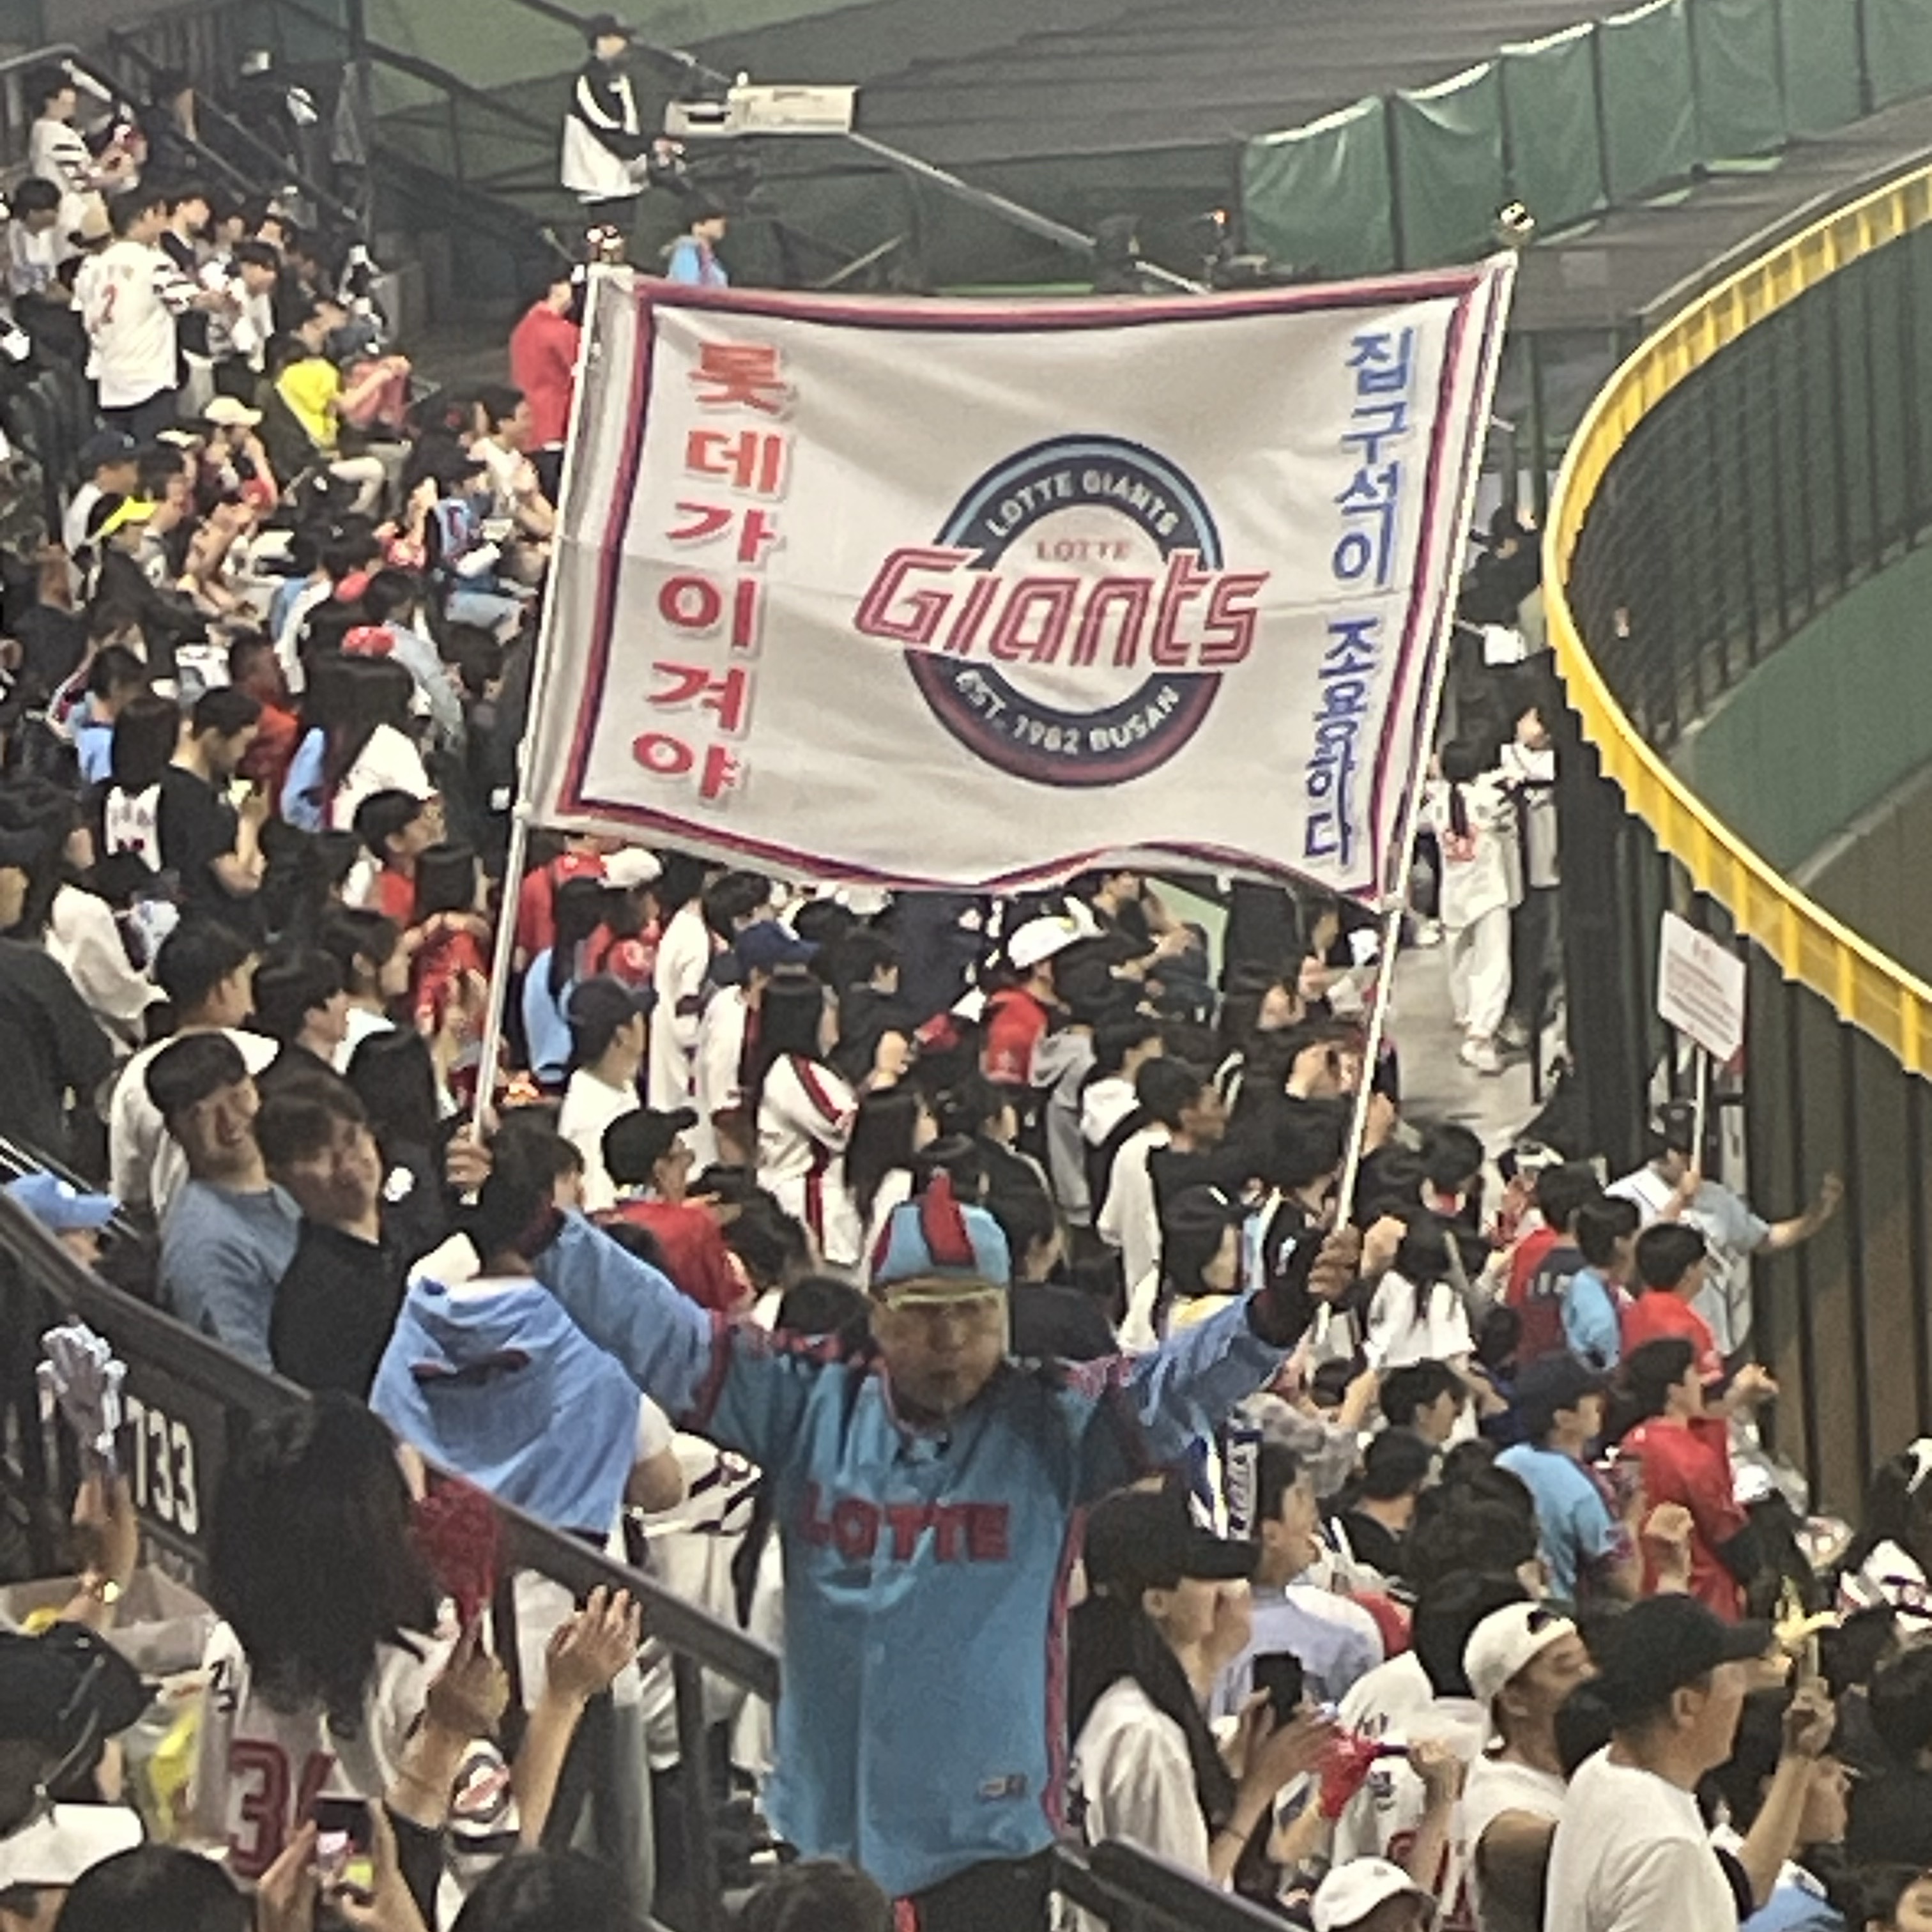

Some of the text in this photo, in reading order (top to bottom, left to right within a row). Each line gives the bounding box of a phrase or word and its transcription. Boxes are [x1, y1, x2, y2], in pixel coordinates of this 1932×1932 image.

[1332, 326, 1414, 588] 집구석이
[984, 469, 1181, 538] LOTTE GIANTS
[1036, 538, 1132, 562] LOTTE
[854, 547, 1271, 668] Giants
[1012, 714, 1082, 755] 1982
[1088, 684, 1181, 753] BUSAN
[795, 1478, 1011, 1562] LOTTE
